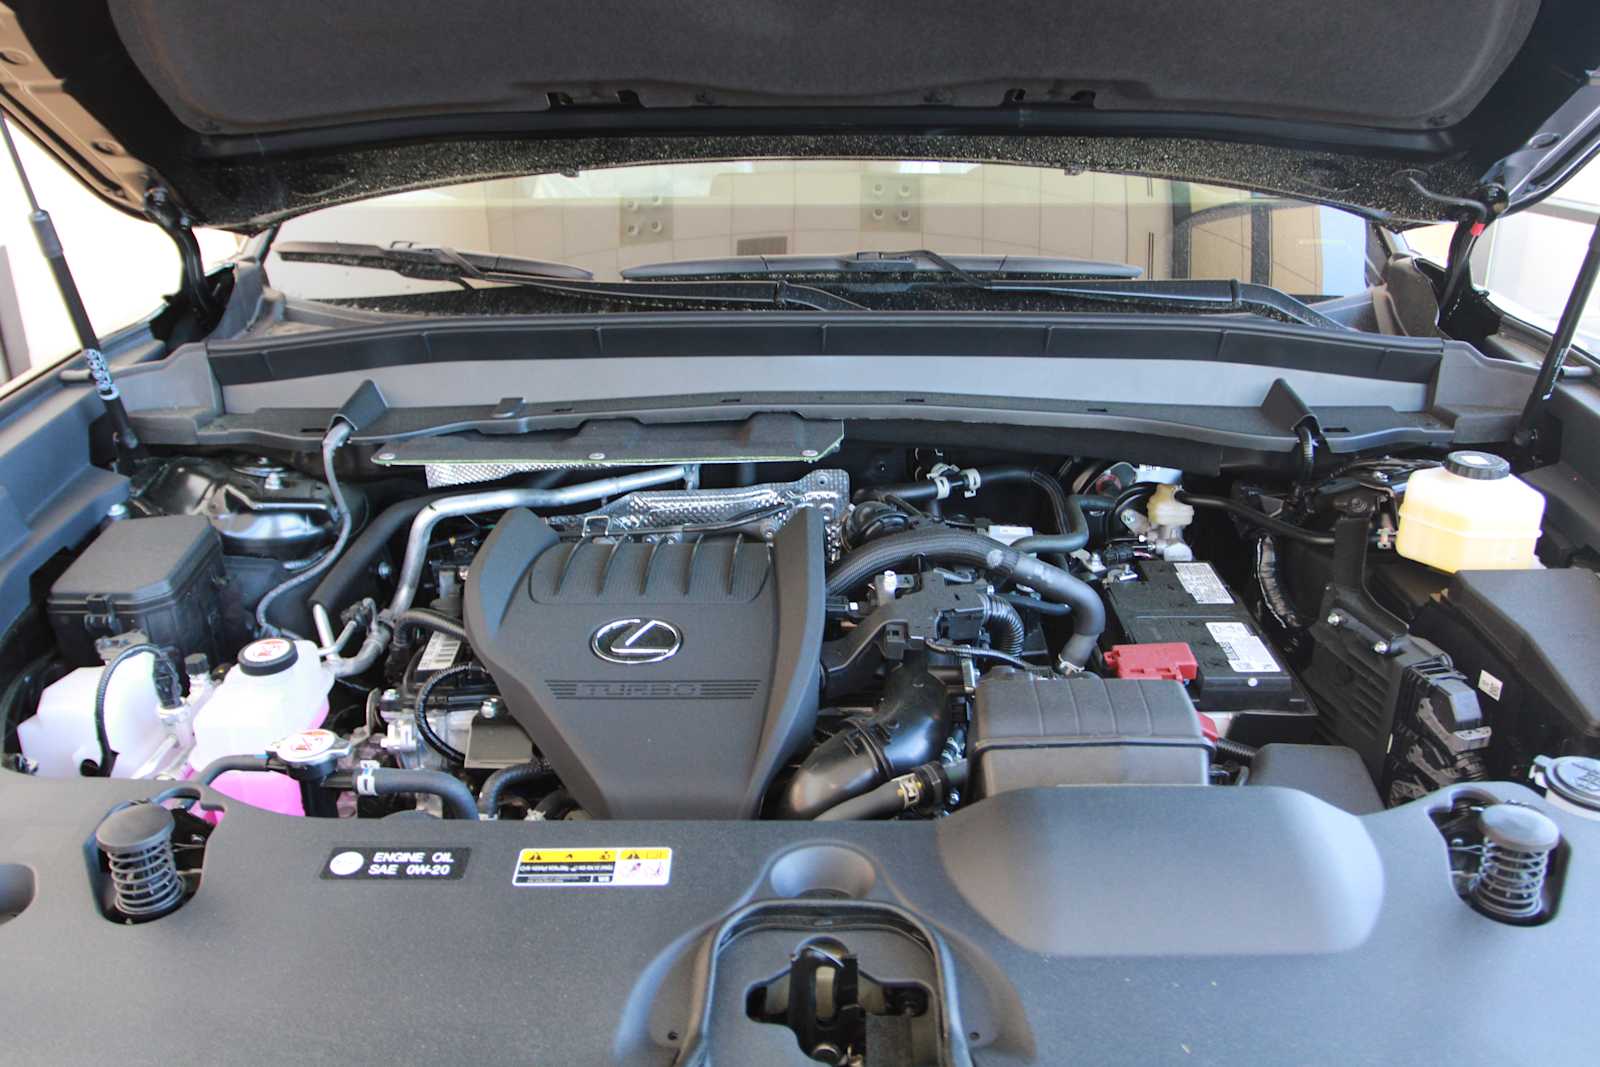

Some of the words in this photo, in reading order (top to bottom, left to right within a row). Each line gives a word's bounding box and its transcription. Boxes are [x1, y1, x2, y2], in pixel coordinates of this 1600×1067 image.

[581, 683, 698, 697] TURBO
[373, 852, 426, 863] ENGINE
[431, 852, 454, 863] OIL
[368, 864, 399, 875] SAE
[406, 864, 450, 875] 0W-20
